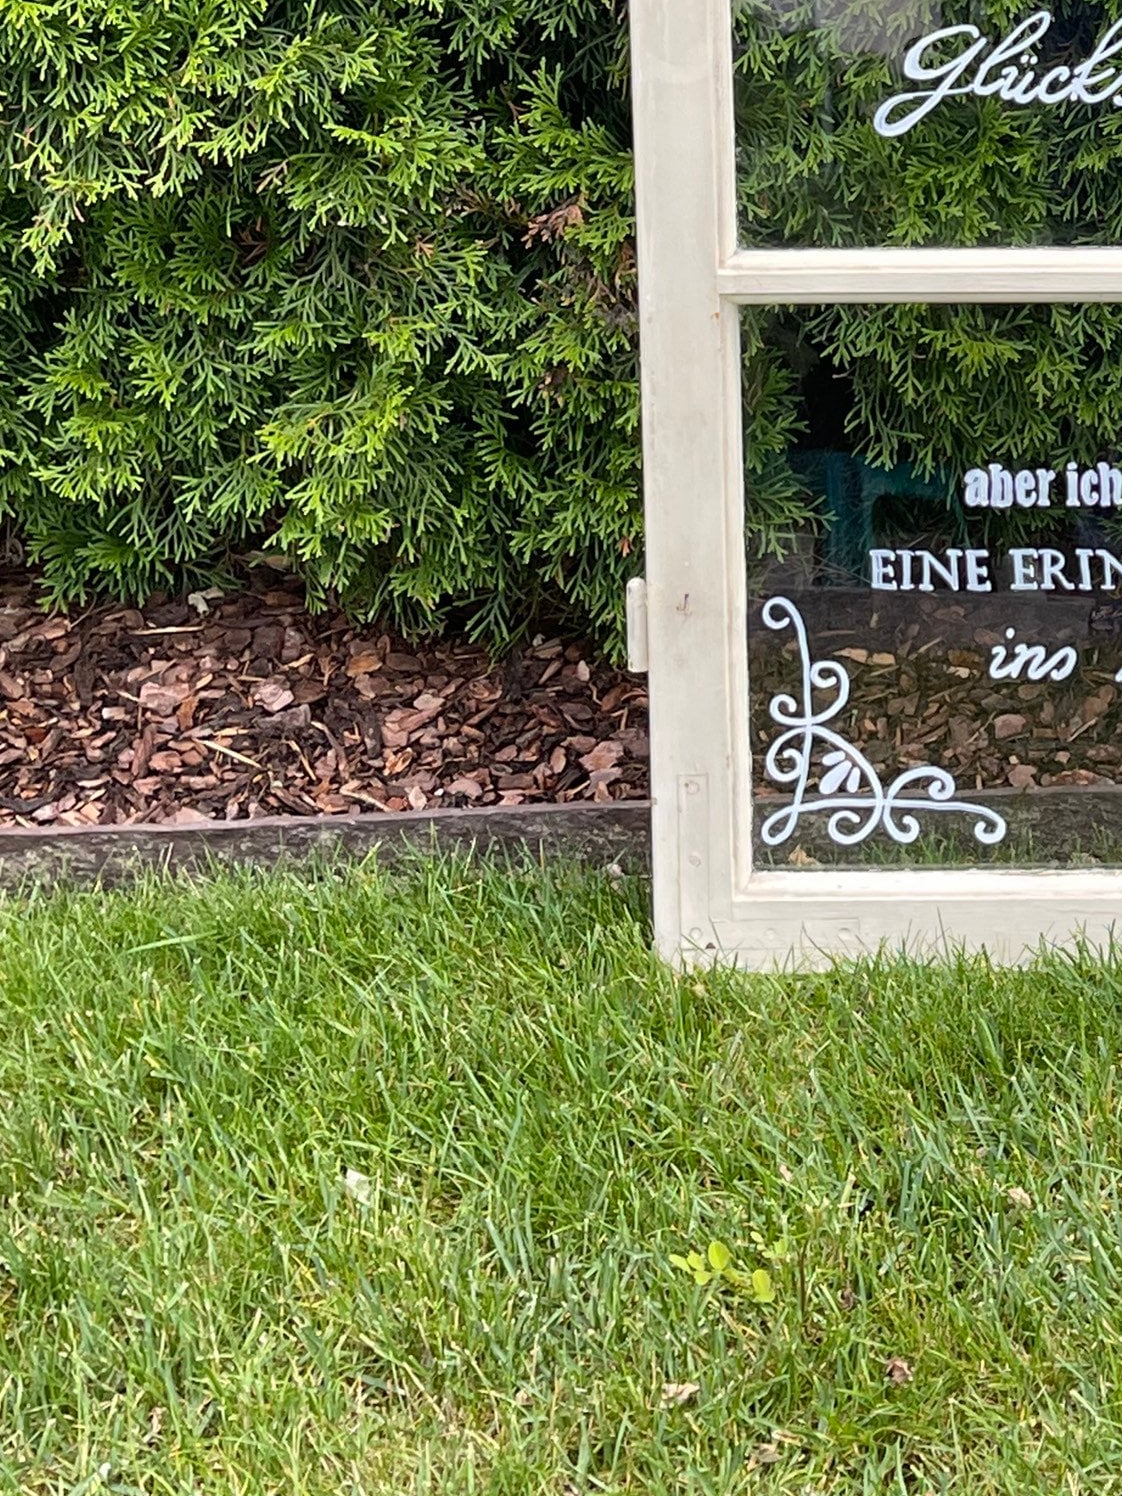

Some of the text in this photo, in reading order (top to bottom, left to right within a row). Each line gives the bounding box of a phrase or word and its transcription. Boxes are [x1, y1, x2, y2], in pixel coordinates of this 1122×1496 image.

[963, 463, 1055, 508] aber
[868, 548, 992, 593] EINE
[988, 628, 1078, 681] ins
